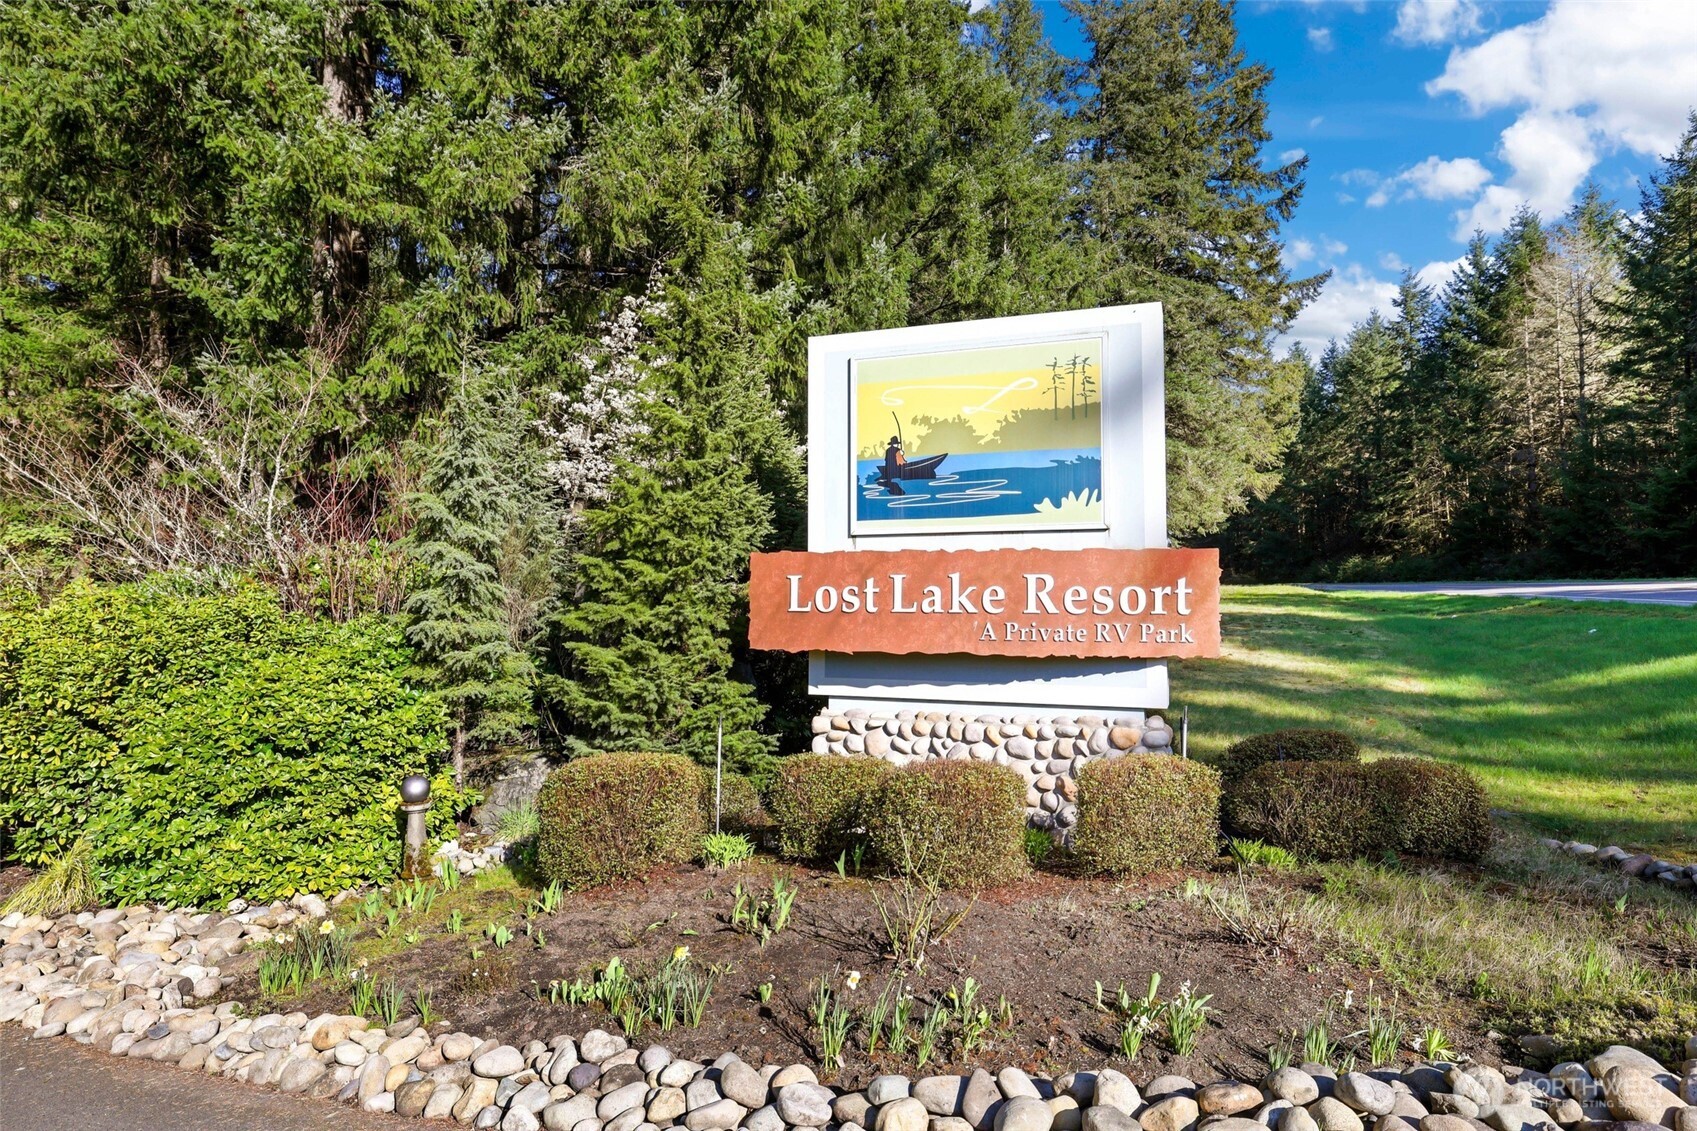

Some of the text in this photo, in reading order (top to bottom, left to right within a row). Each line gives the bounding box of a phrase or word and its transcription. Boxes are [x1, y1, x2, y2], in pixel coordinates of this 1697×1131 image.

[786, 572, 1193, 616] Lost Lake Resort
[979, 621, 1195, 644] A Private RV Park
